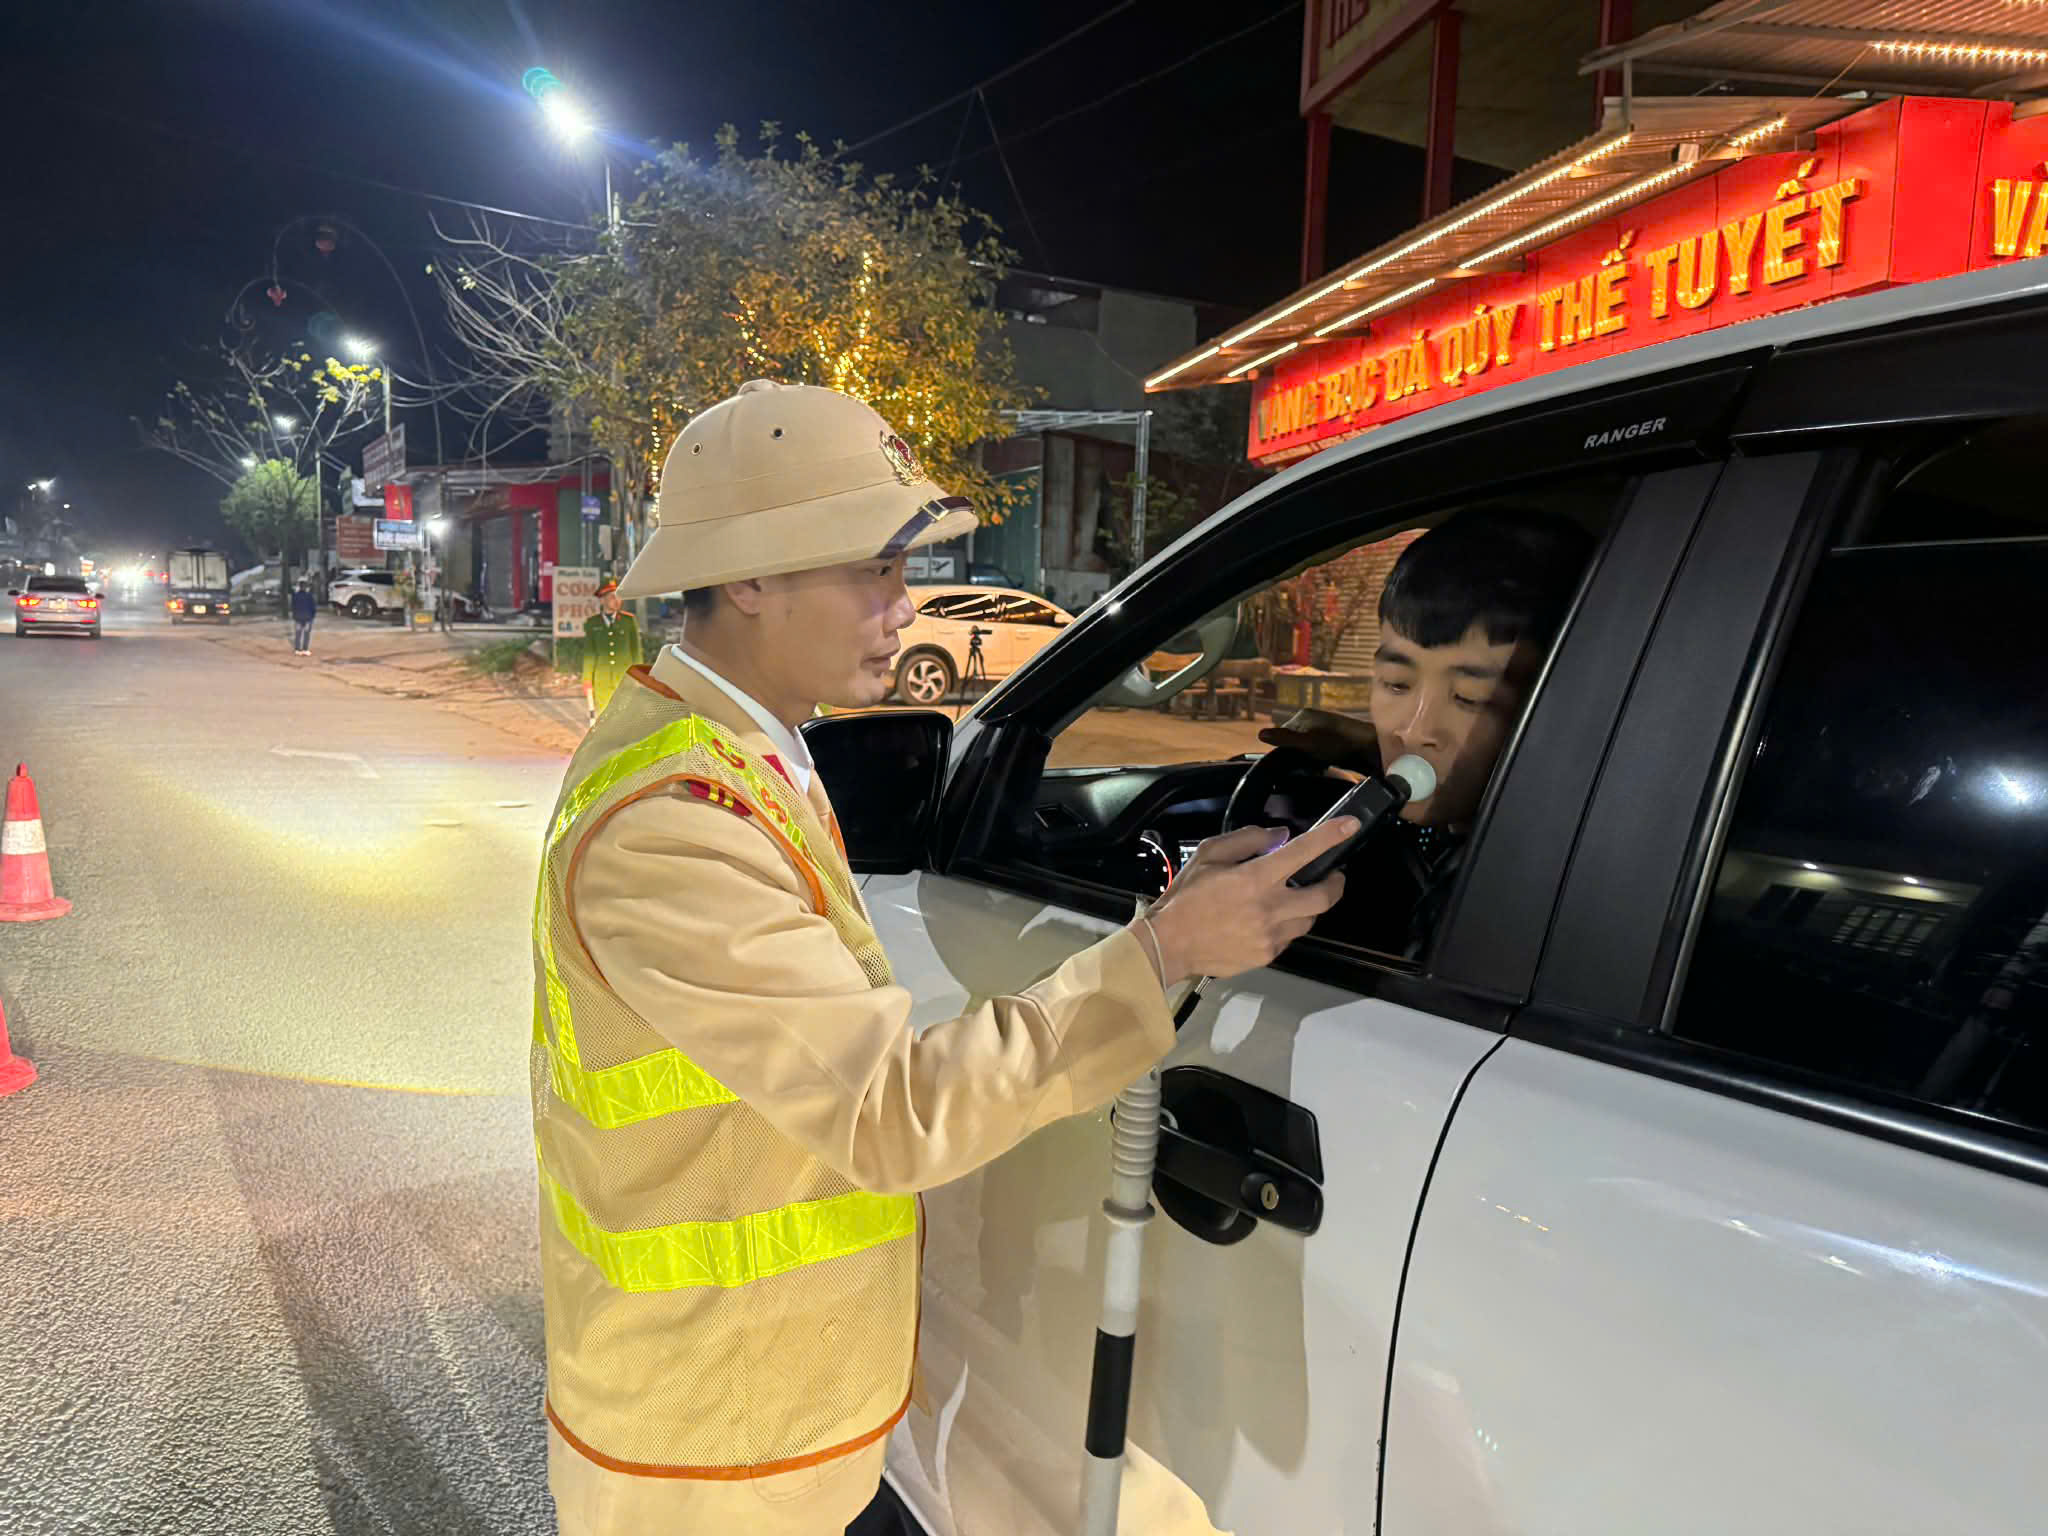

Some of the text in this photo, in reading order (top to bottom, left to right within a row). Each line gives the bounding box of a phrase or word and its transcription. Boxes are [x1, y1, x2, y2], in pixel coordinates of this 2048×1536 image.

[1538, 230, 1634, 352] THẾ
[1646, 158, 1857, 319] TUYẾT
[1584, 417, 1667, 449] RANGER
